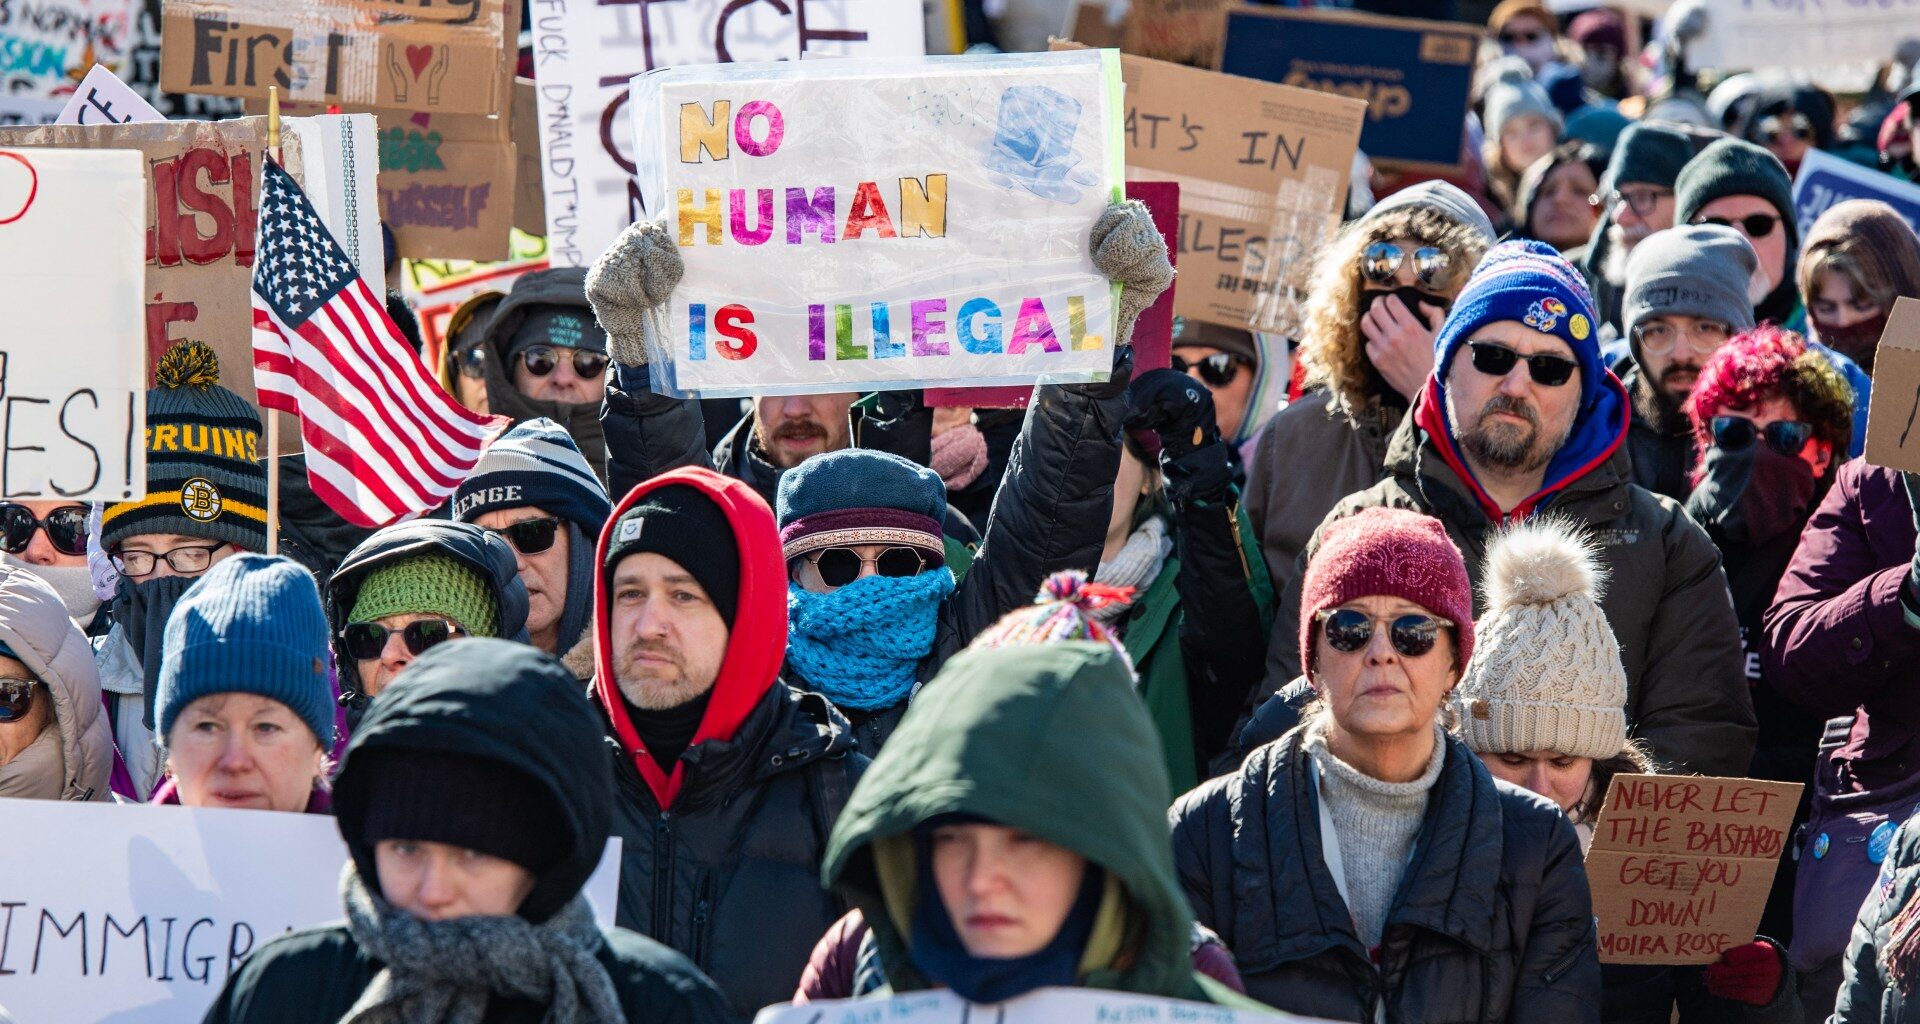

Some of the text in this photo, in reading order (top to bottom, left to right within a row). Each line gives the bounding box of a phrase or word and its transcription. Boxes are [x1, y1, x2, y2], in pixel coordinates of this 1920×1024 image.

[190, 12, 355, 95] First
[680, 100, 784, 163] NO
[1236, 131, 1305, 170] IN
[676, 173, 948, 246] HUMAN
[688, 296, 1104, 361] IS ILLEGAL
[1613, 780, 1779, 816] NEVER LET
[1607, 816, 1672, 847] THE
[1686, 821, 1784, 859] BASTARDS
[1619, 856, 1742, 896] GET YOU
[1626, 890, 1717, 927] DOWN!
[0, 902, 256, 984] IMMIGR
[1674, 932, 1732, 956] ROSE
